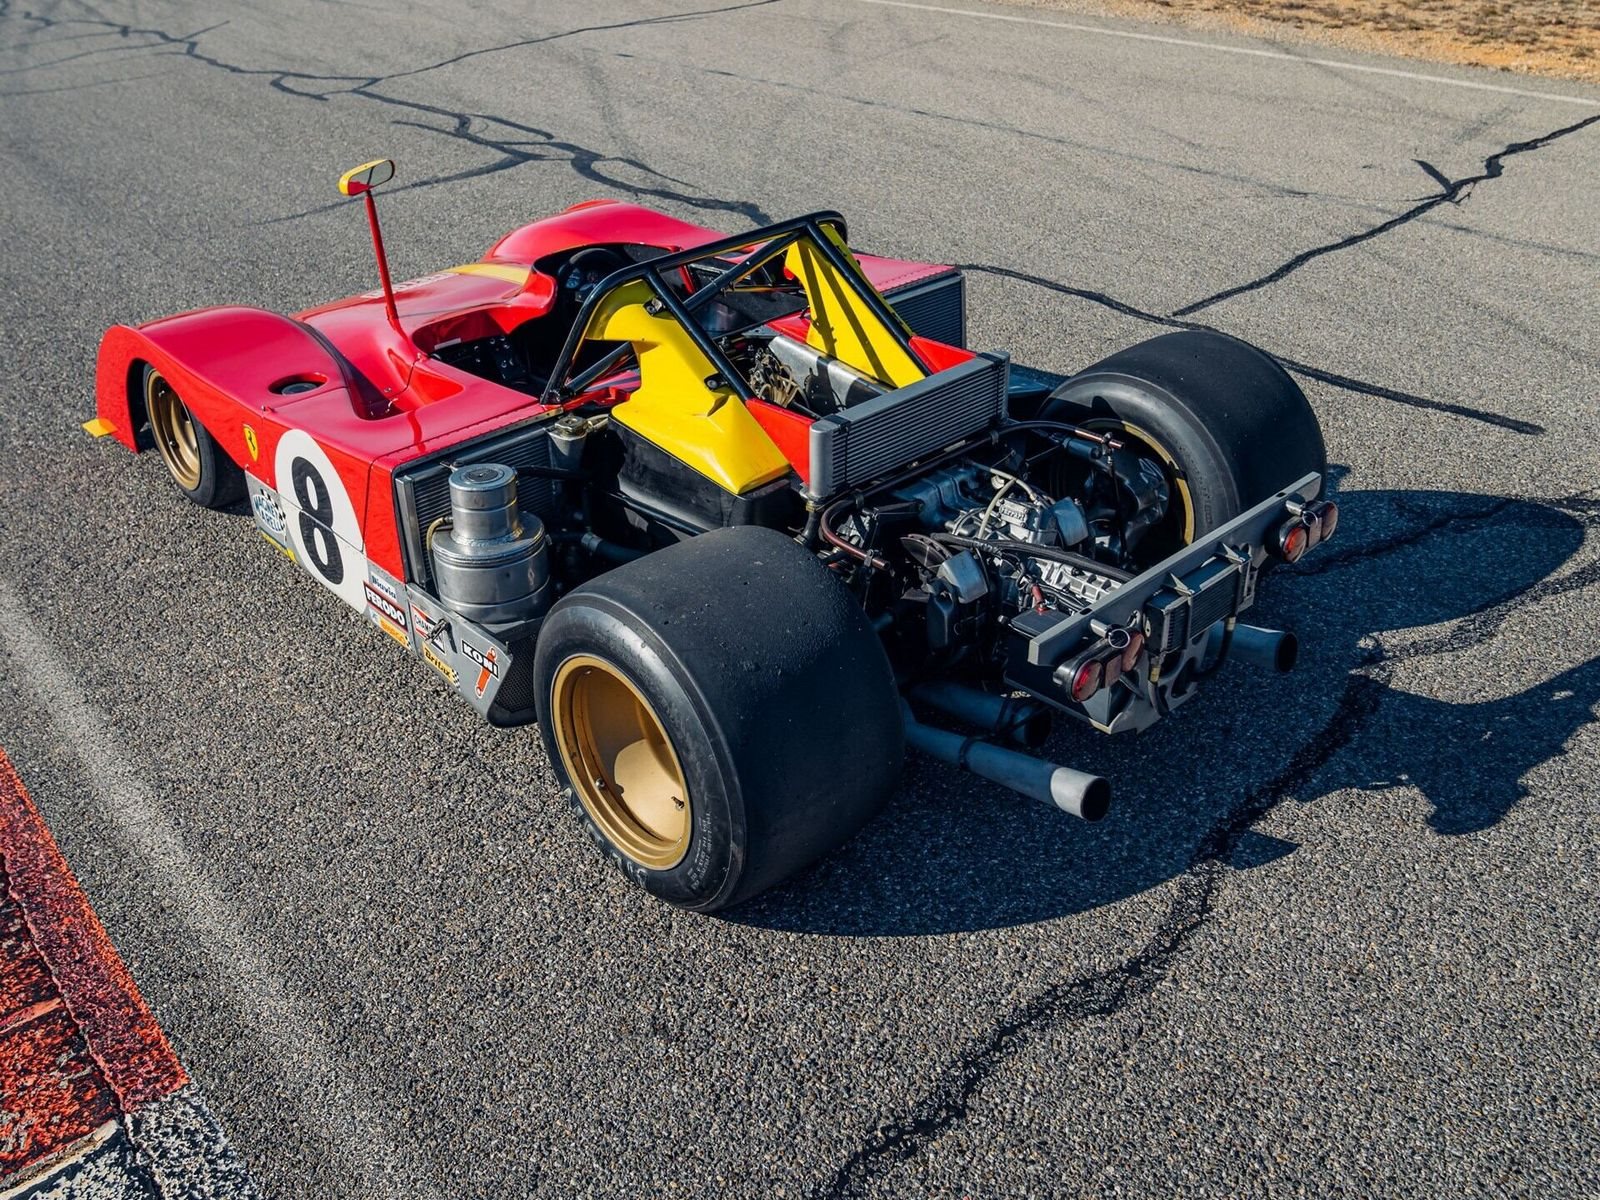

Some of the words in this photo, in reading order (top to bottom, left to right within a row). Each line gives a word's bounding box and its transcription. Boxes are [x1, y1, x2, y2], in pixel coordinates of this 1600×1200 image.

[292, 456, 344, 585] 8
[365, 586, 405, 626] FERODO
[424, 647, 451, 678] Britax
[463, 641, 497, 677] KONI
